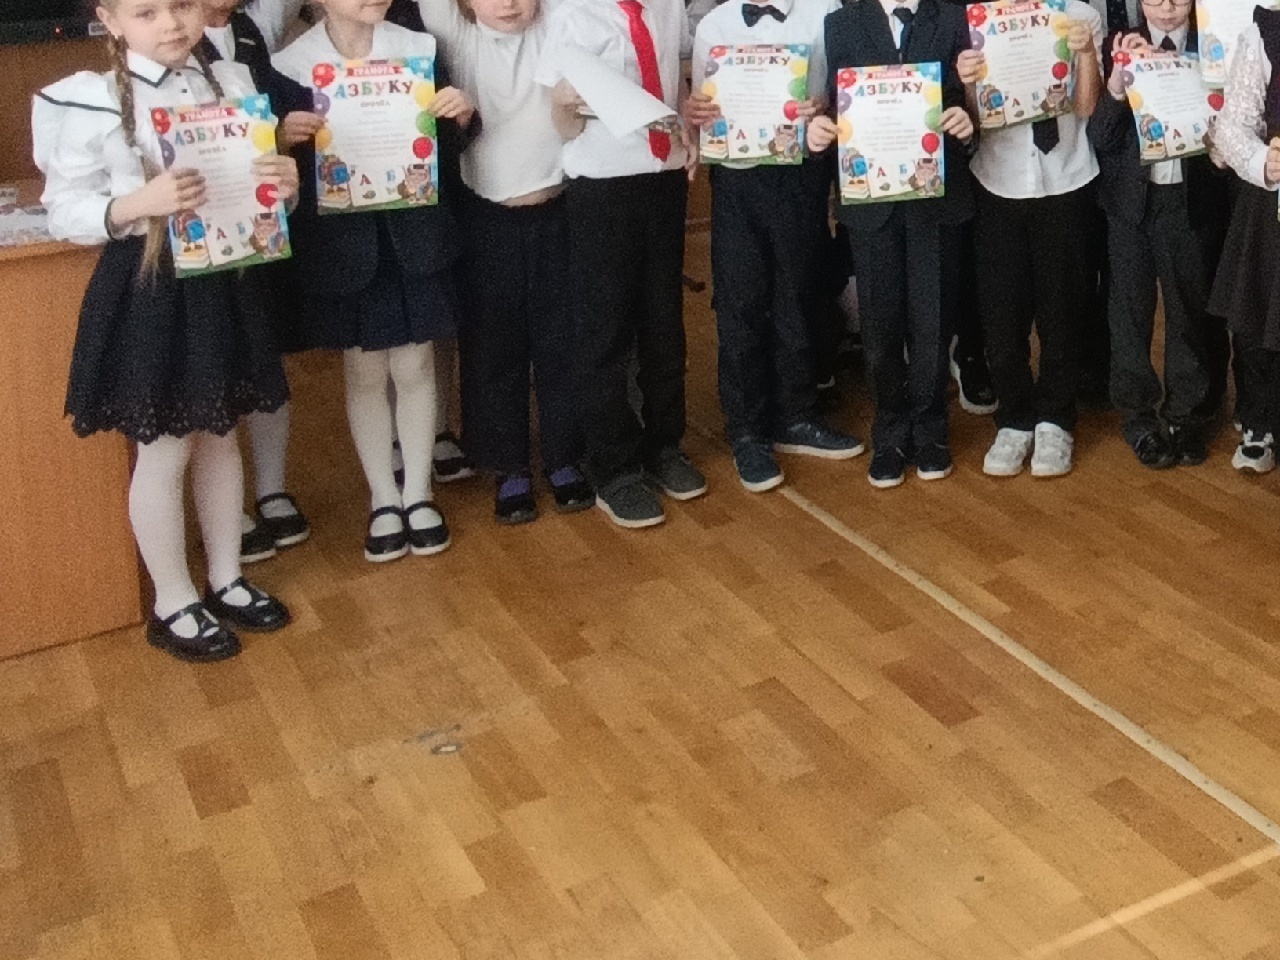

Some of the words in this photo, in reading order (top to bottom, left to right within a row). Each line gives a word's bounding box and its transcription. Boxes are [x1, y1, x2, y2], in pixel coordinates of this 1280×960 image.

[987, 14, 1050, 36] АЗБУКУ
[722, 56, 791, 66] АЗБУКУ
[334, 80, 414, 100] АЗБУКУ
[854, 81, 923, 96] АЗБУКУ
[174, 122, 250, 146] АЗБУКУ
[877, 166, 886, 178] А
